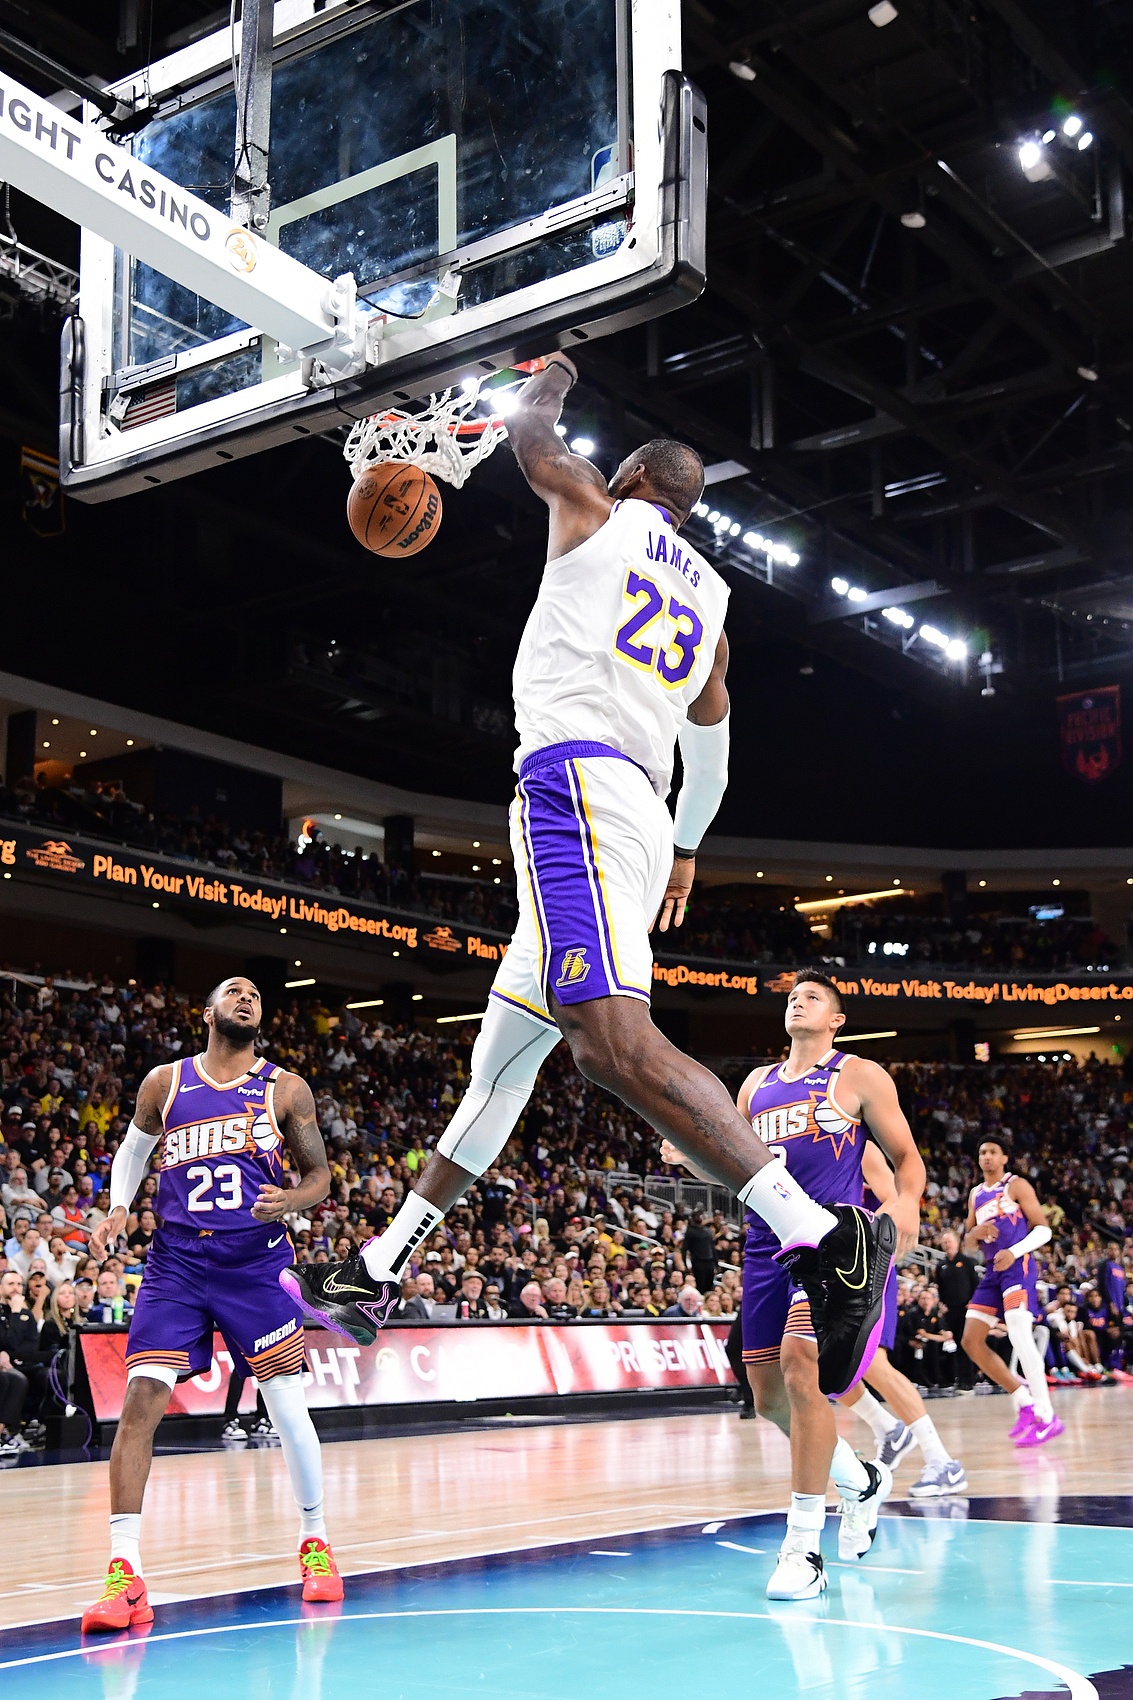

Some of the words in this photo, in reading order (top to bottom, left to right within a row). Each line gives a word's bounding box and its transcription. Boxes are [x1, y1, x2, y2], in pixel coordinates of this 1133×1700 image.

[95, 153, 210, 241] CASINO
[397, 493, 438, 549] Wilson
[646, 531, 700, 588] JAMES
[613, 567, 705, 691] 23
[93, 854, 138, 886] Plan
[140, 864, 184, 894] Your
[186, 874, 228, 904] Visit
[230, 884, 287, 920] Today!
[290, 897, 418, 948] LivingDesert.org
[467, 936, 498, 960] Plan
[651, 962, 758, 995] ingDesert.org
[860, 978, 900, 996] Your
[902, 979, 942, 998] Visit
[943, 981, 999, 1004] Today!
[238, 1086, 264, 1097] PayPal
[803, 1077, 828, 1086] PayPal
[165, 1117, 248, 1167] SUNS
[752, 1104, 809, 1143] UNS
[186, 1164, 243, 1212] 23
[254, 1317, 297, 1353] PHOENIX
